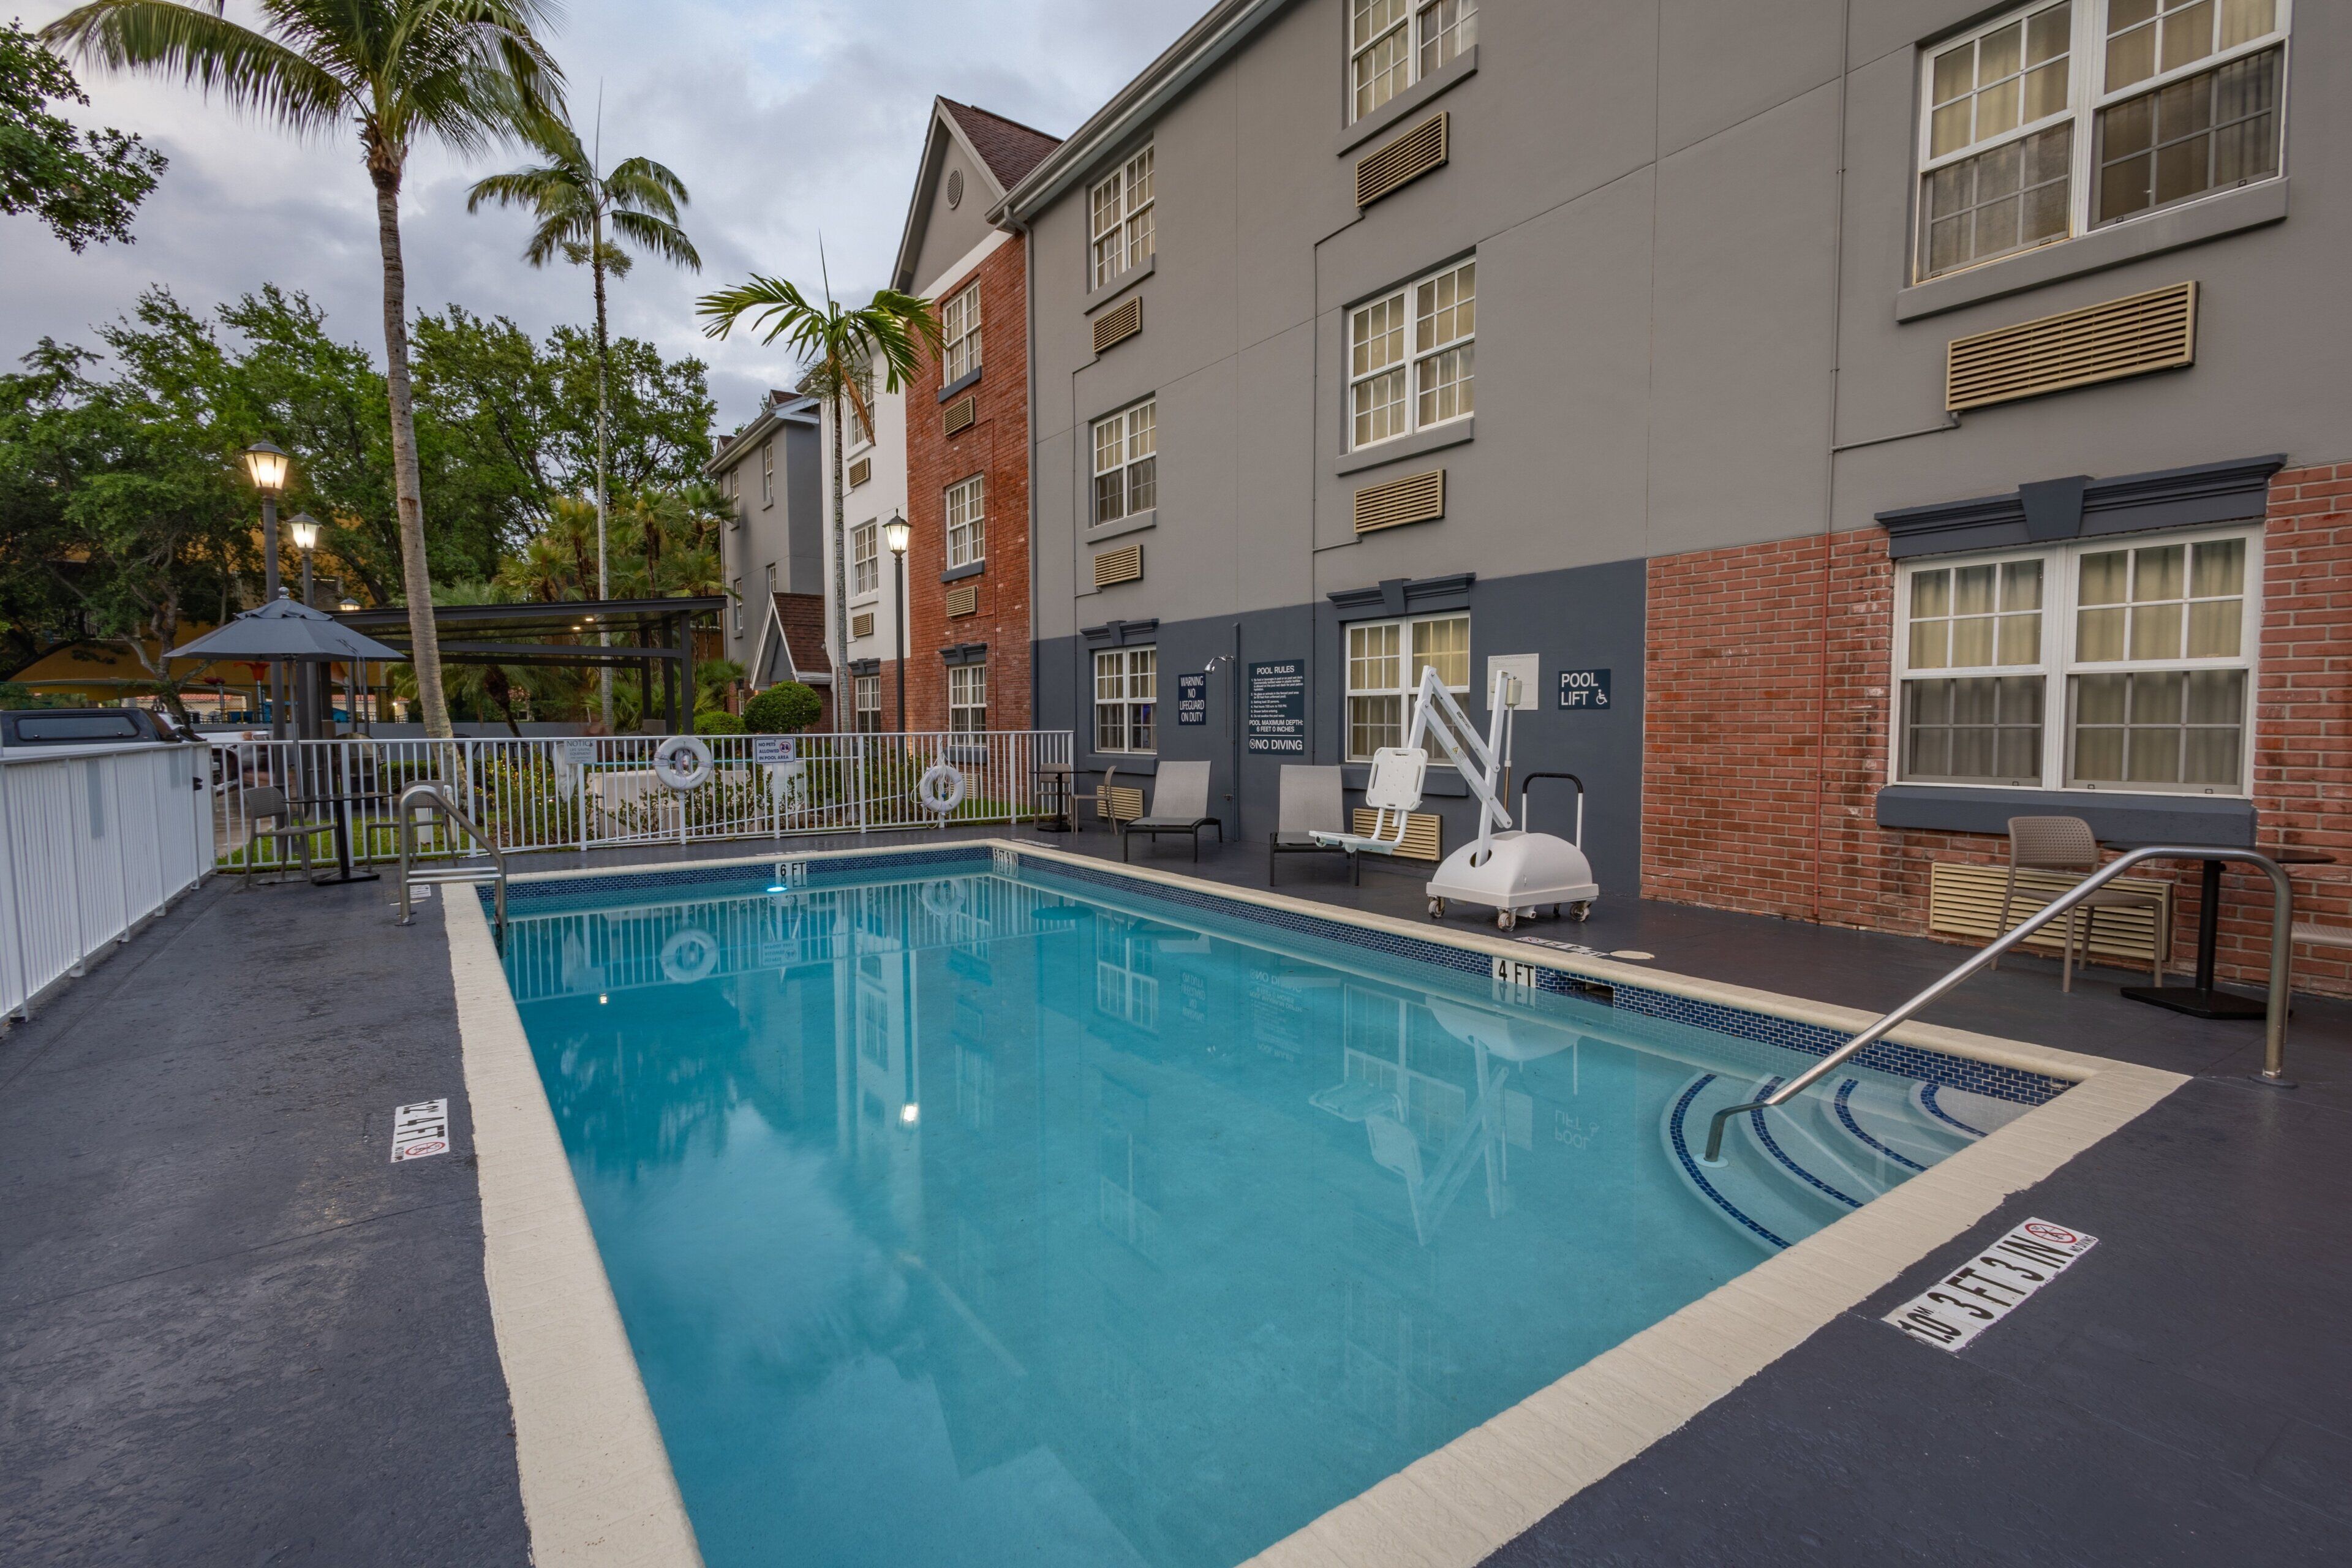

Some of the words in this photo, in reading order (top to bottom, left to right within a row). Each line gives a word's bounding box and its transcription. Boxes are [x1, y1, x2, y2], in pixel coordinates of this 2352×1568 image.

[1274, 665, 1295, 674] RULES
[1180, 676, 1204, 687] WARNING
[1561, 672, 1599, 687] POOL
[1188, 688, 1196, 698] NO
[1561, 691, 1589, 705] LIFT
[1180, 700, 1205, 710] LIFEGUARD
[1181, 712, 1188, 722] ON
[1189, 712, 1203, 722] DUTY
[1256, 739, 1268, 750] NO
[1271, 739, 1303, 750] DIVING
[994, 849, 998, 861] 5
[999, 850, 1005, 862] FT
[1006, 852, 1010, 864] 9
[1011, 853, 1017, 865] IN
[780, 864, 786, 876] 6
[792, 862, 805, 875] FT
[1499, 960, 1507, 981] 4
[1515, 962, 1534, 987] FT
[398, 1117, 444, 1127] 4
[396, 1125, 445, 1144] FT
[1996, 1235, 2075, 1269] IN
[1980, 1257, 2045, 1281] 3
[1945, 1267, 2027, 1307] FT
[1927, 1292, 1994, 1320] 3
